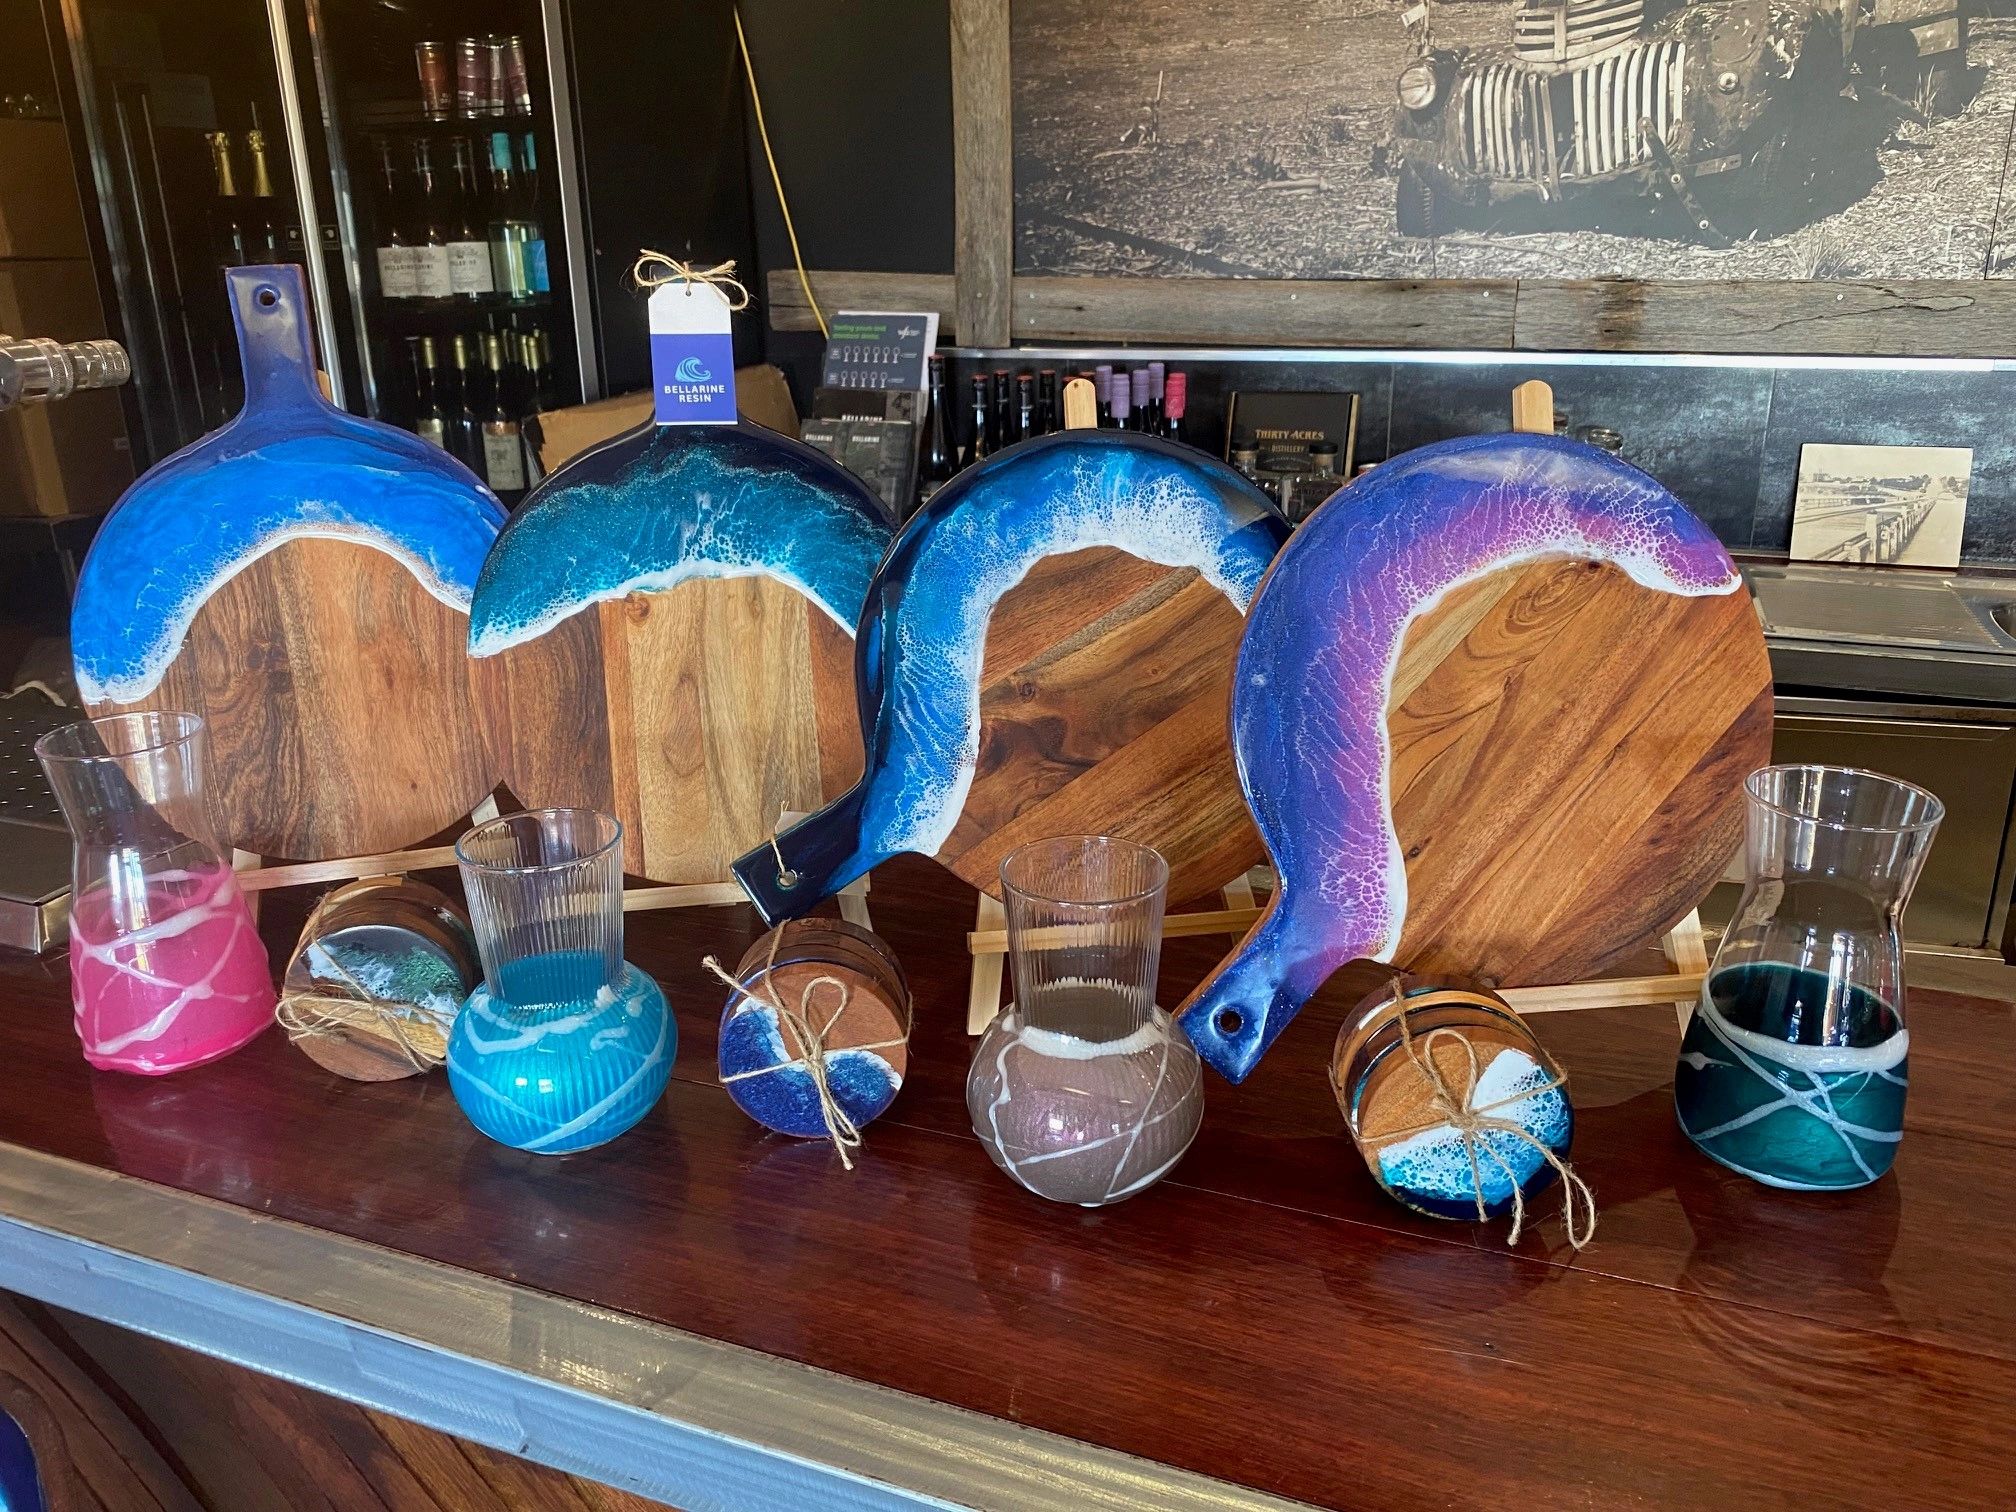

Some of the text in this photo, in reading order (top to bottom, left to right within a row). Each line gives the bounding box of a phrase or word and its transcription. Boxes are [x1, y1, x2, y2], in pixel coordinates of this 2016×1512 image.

[664, 384, 726, 394] BELLARINE
[679, 394, 712, 403] RESIN
[1255, 429, 1325, 440] THIRTY ACRES
